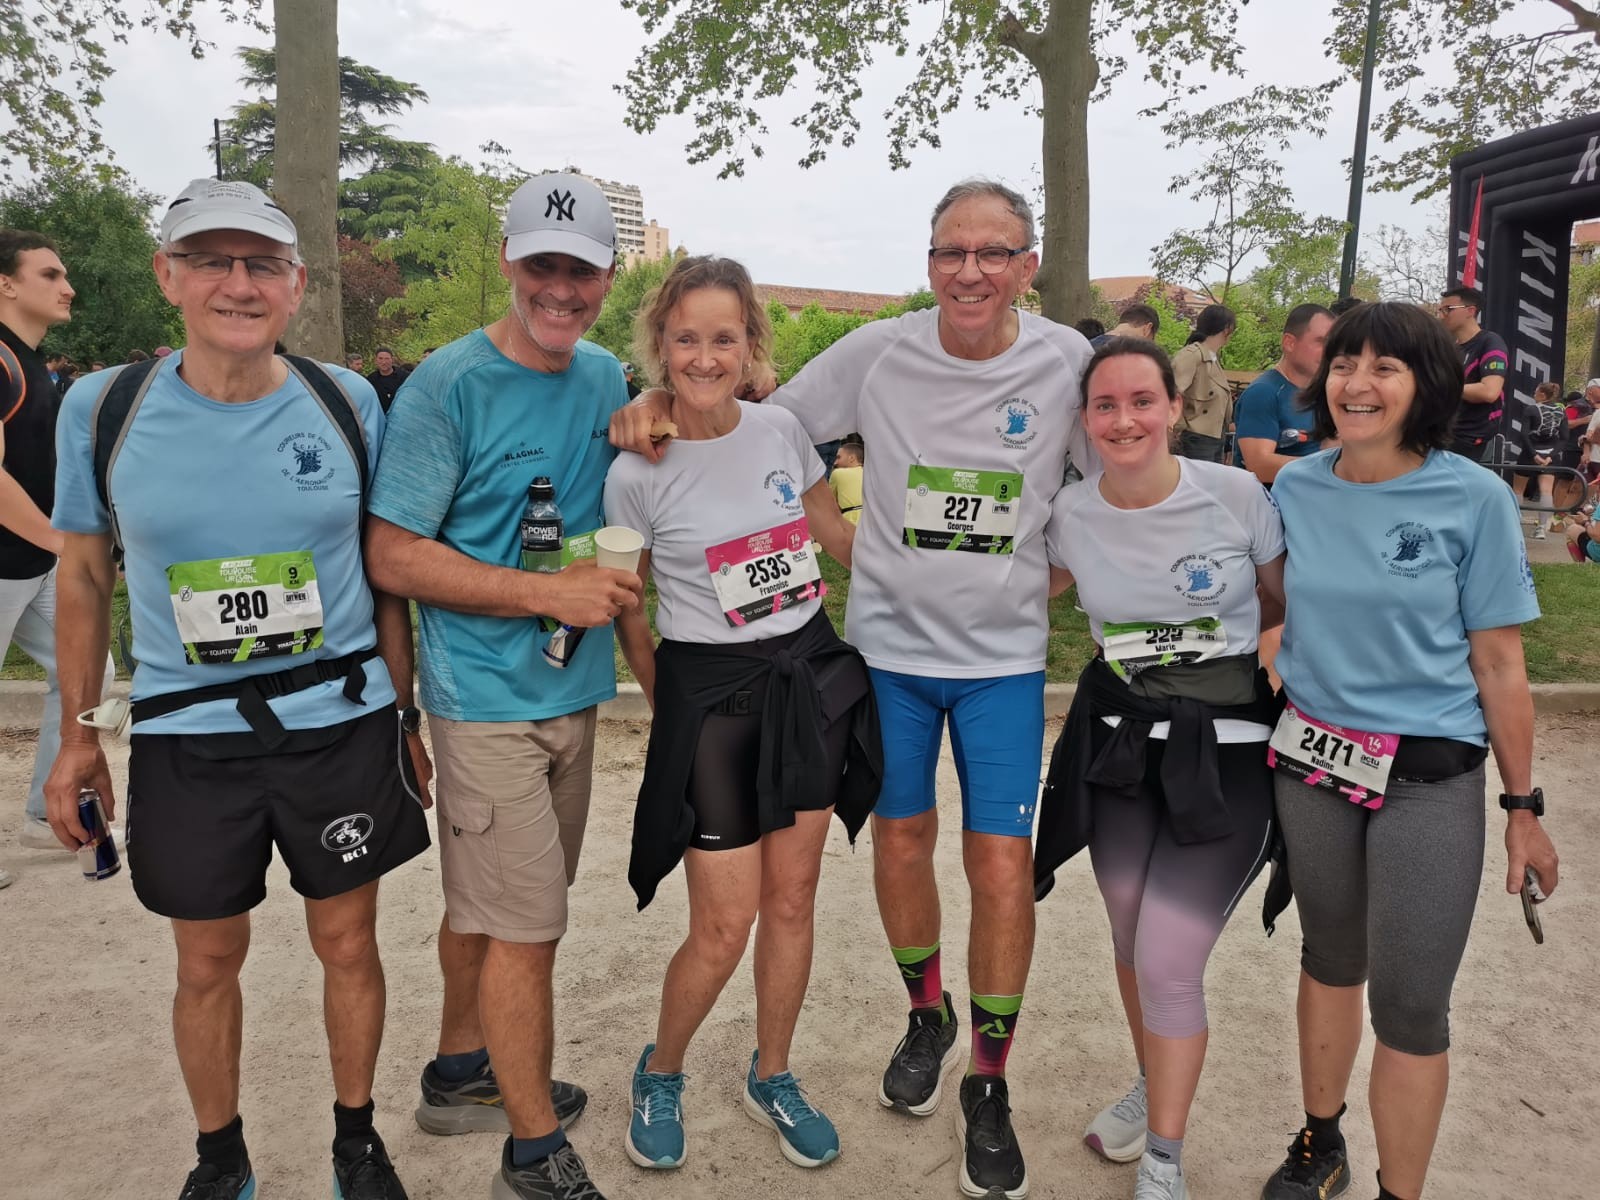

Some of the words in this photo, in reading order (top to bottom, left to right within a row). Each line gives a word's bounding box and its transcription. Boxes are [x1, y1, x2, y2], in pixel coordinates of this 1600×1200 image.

[544, 188, 576, 221] NY
[504, 447, 545, 461] BLAGNAC
[1000, 484, 1008, 494] 9
[944, 496, 982, 521] 227
[528, 526, 558, 534] POWER
[947, 521, 974, 533] Georges
[541, 533, 558, 541] ADE
[288, 566, 298, 579] 9
[745, 552, 791, 588] 2535
[760, 580, 790, 597] Françoise
[218, 590, 269, 625] 280
[235, 624, 258, 636] Alain
[1155, 643, 1176, 653] Marie
[1300, 726, 1354, 767] 2471
[1368, 736, 1382, 750] 14
[1311, 755, 1335, 771] Nadine
[1361, 755, 1380, 767] actu
